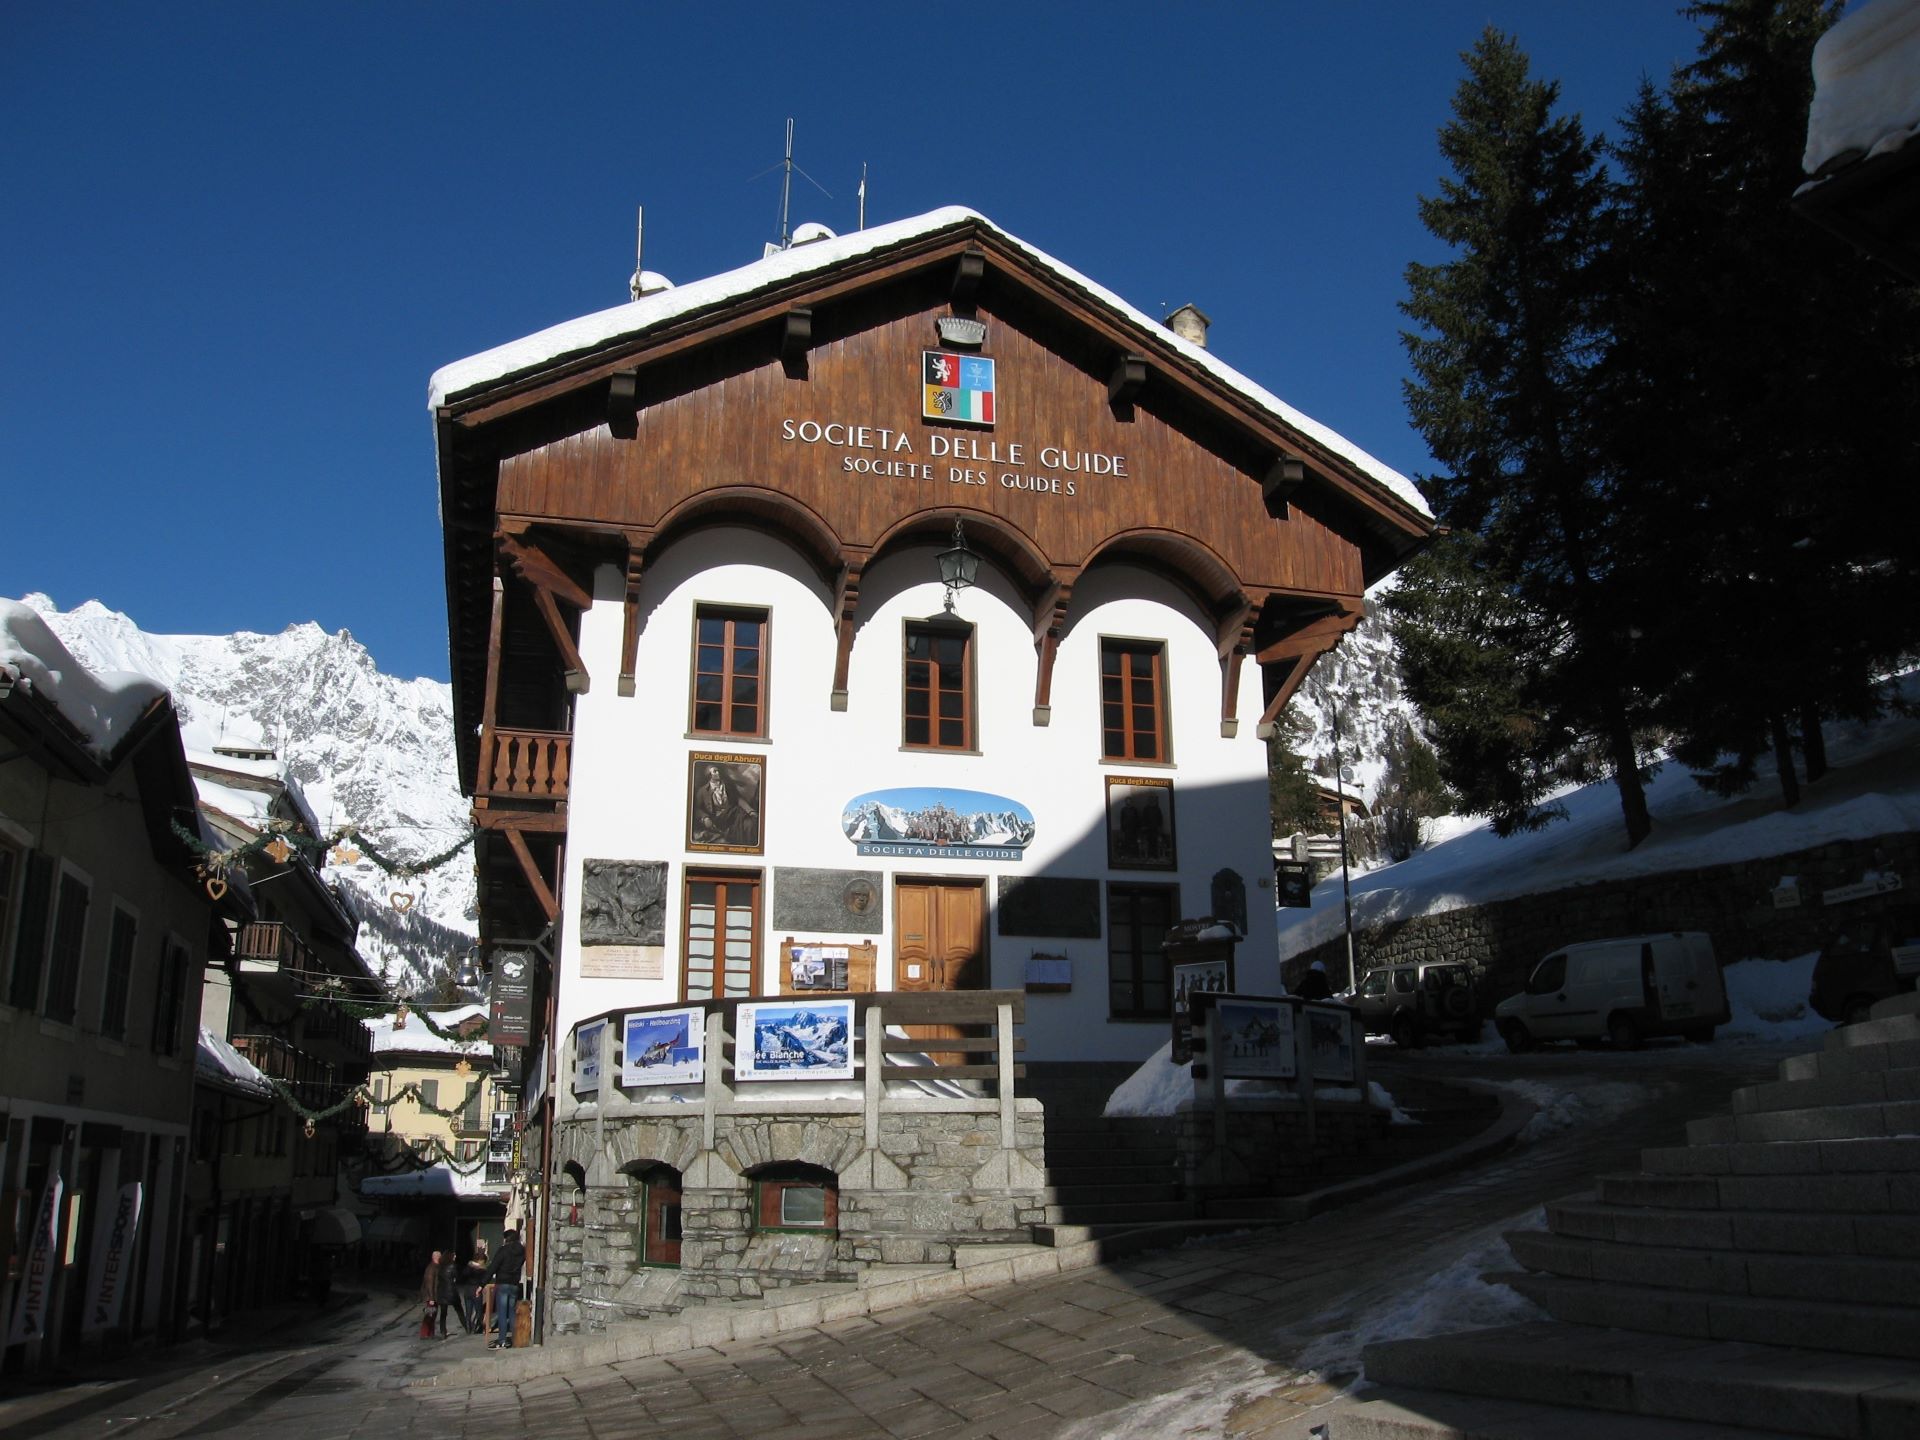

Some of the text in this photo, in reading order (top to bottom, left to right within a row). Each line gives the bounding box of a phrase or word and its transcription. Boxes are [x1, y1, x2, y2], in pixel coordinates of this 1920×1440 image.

[782, 418, 1129, 478] SOCIETA DELLE GUIDE
[843, 455, 1076, 496] SOCIETE DES GUIDES
[694, 753, 762, 764] Duca degli Abruzzi
[863, 845, 1018, 860] SOCIETA' DELLE GUIDE
[769, 1049, 805, 1060] Blanche
[25, 1186, 56, 1312] INTERSPORT
[98, 1194, 133, 1305] INTERSPORT
